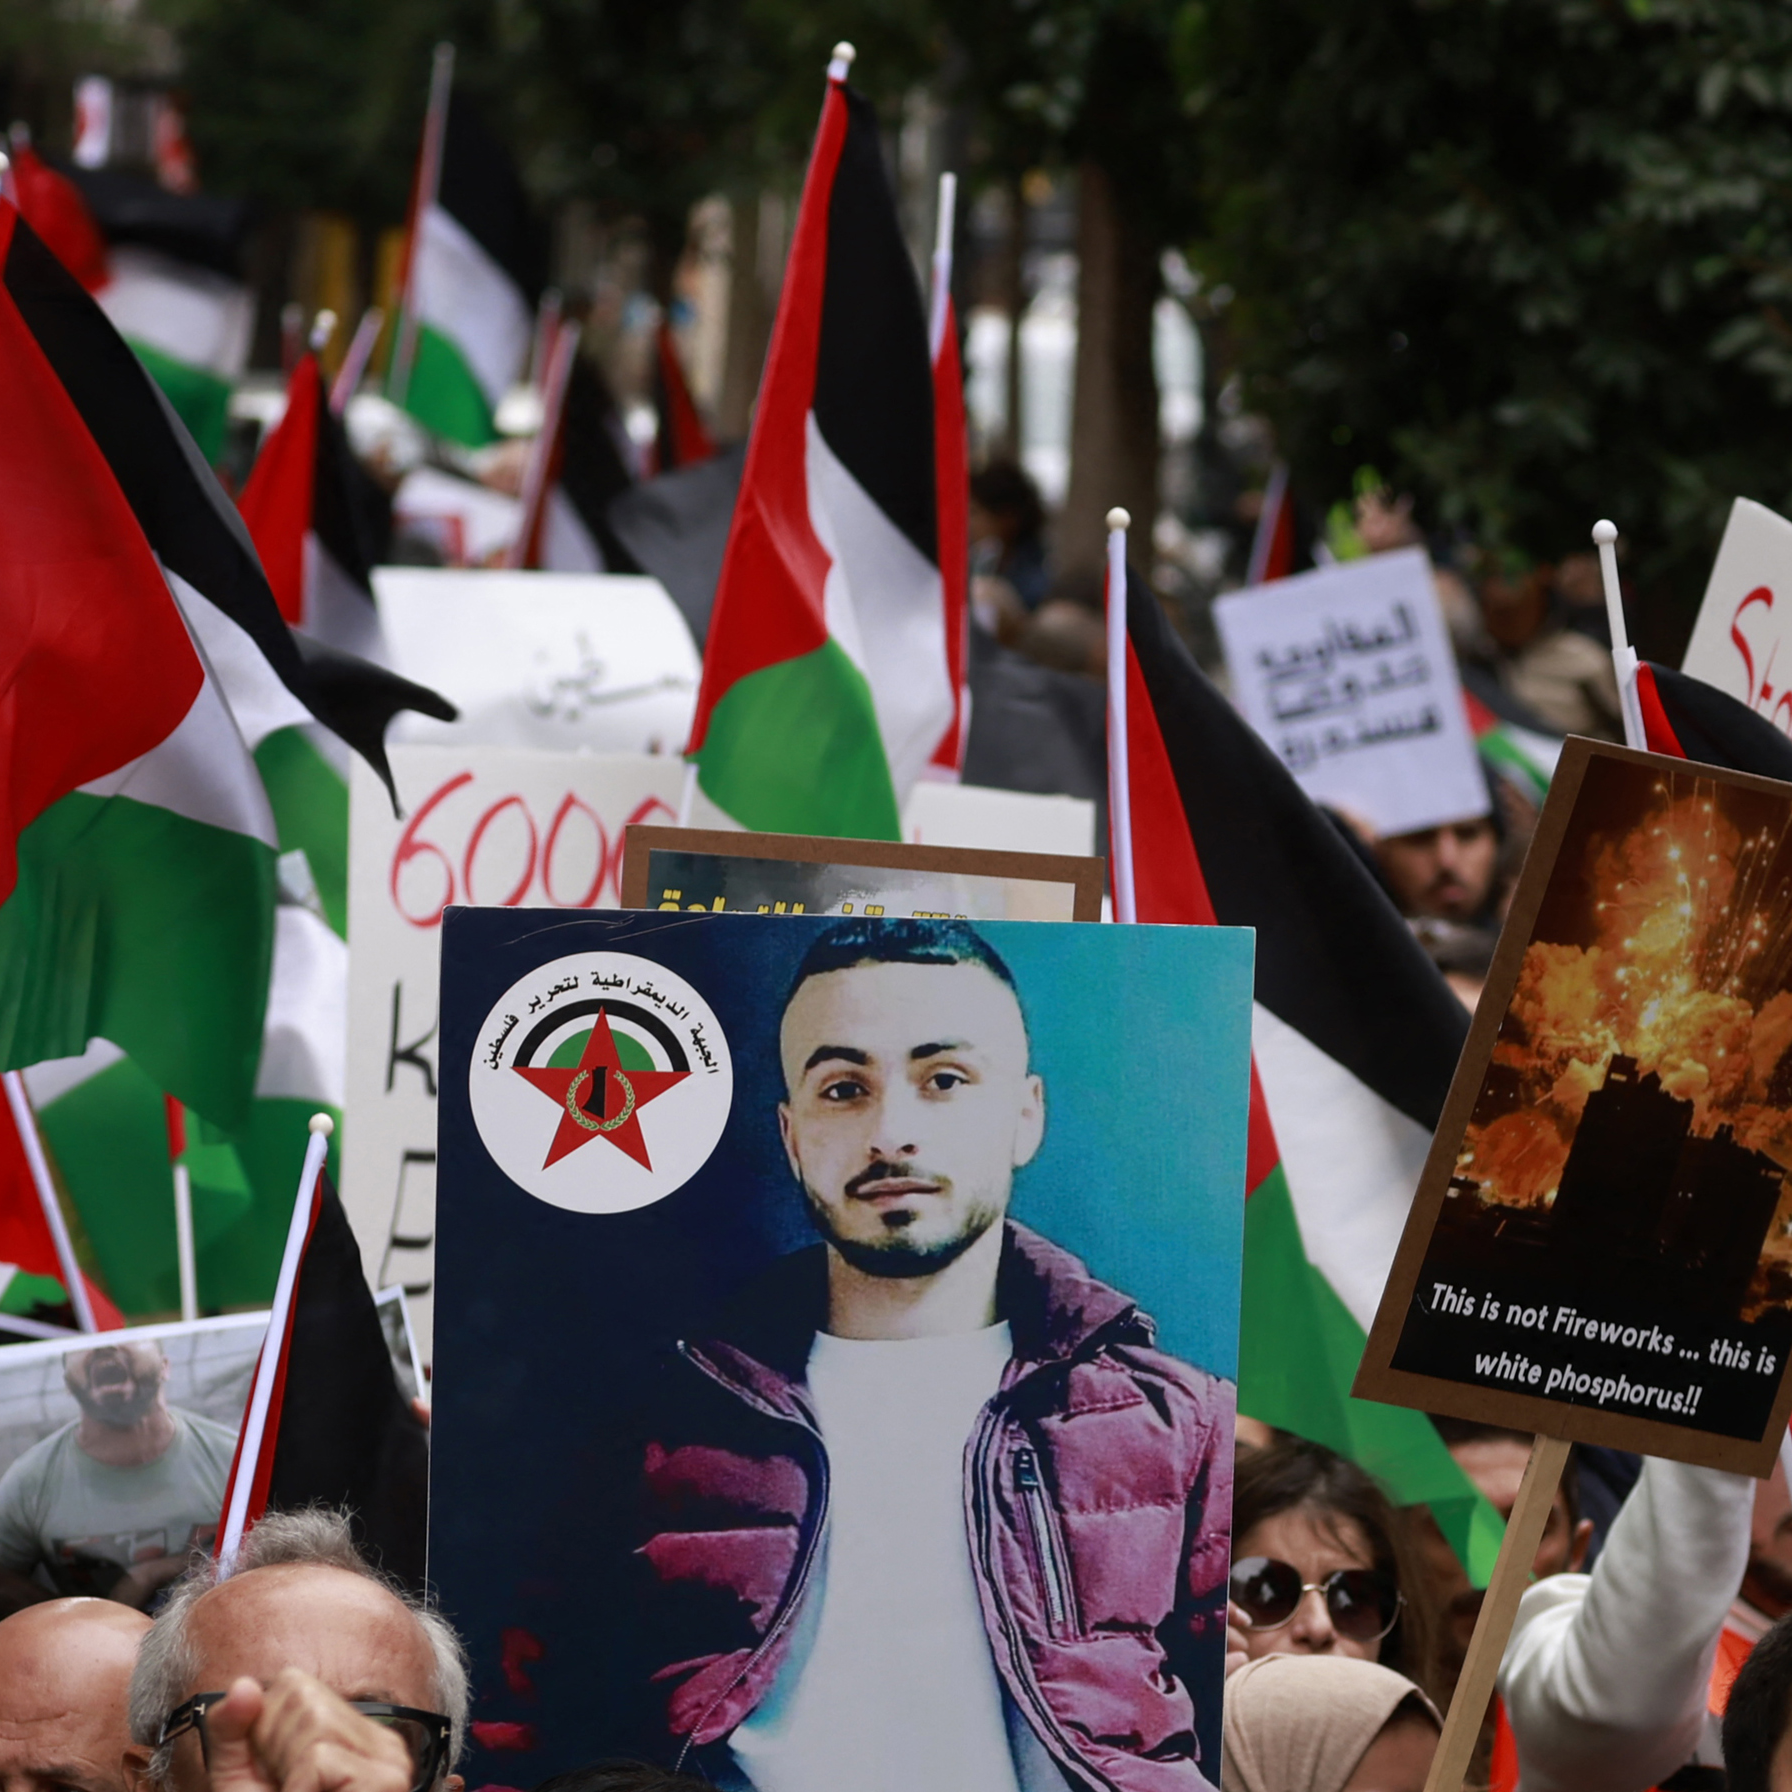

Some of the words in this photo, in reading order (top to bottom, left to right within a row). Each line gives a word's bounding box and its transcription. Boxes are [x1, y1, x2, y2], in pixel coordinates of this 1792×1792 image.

[527, 975, 579, 1015] لتحرير
[591, 971, 691, 1021] الديمقراطية
[483, 1013, 520, 1071] فلسطين
[690, 1021, 719, 1075] الجبهة
[1430, 1282, 1476, 1317] This
[1479, 1292, 1501, 1322] is
[1506, 1303, 1549, 1332] not
[1552, 1306, 1674, 1356] Fireworks
[1678, 1345, 1700, 1362] ...
[1709, 1338, 1752, 1372] this
[1755, 1346, 1777, 1376] is
[1474, 1352, 1543, 1386] white
[1545, 1363, 1703, 1416] phosphorus!!
